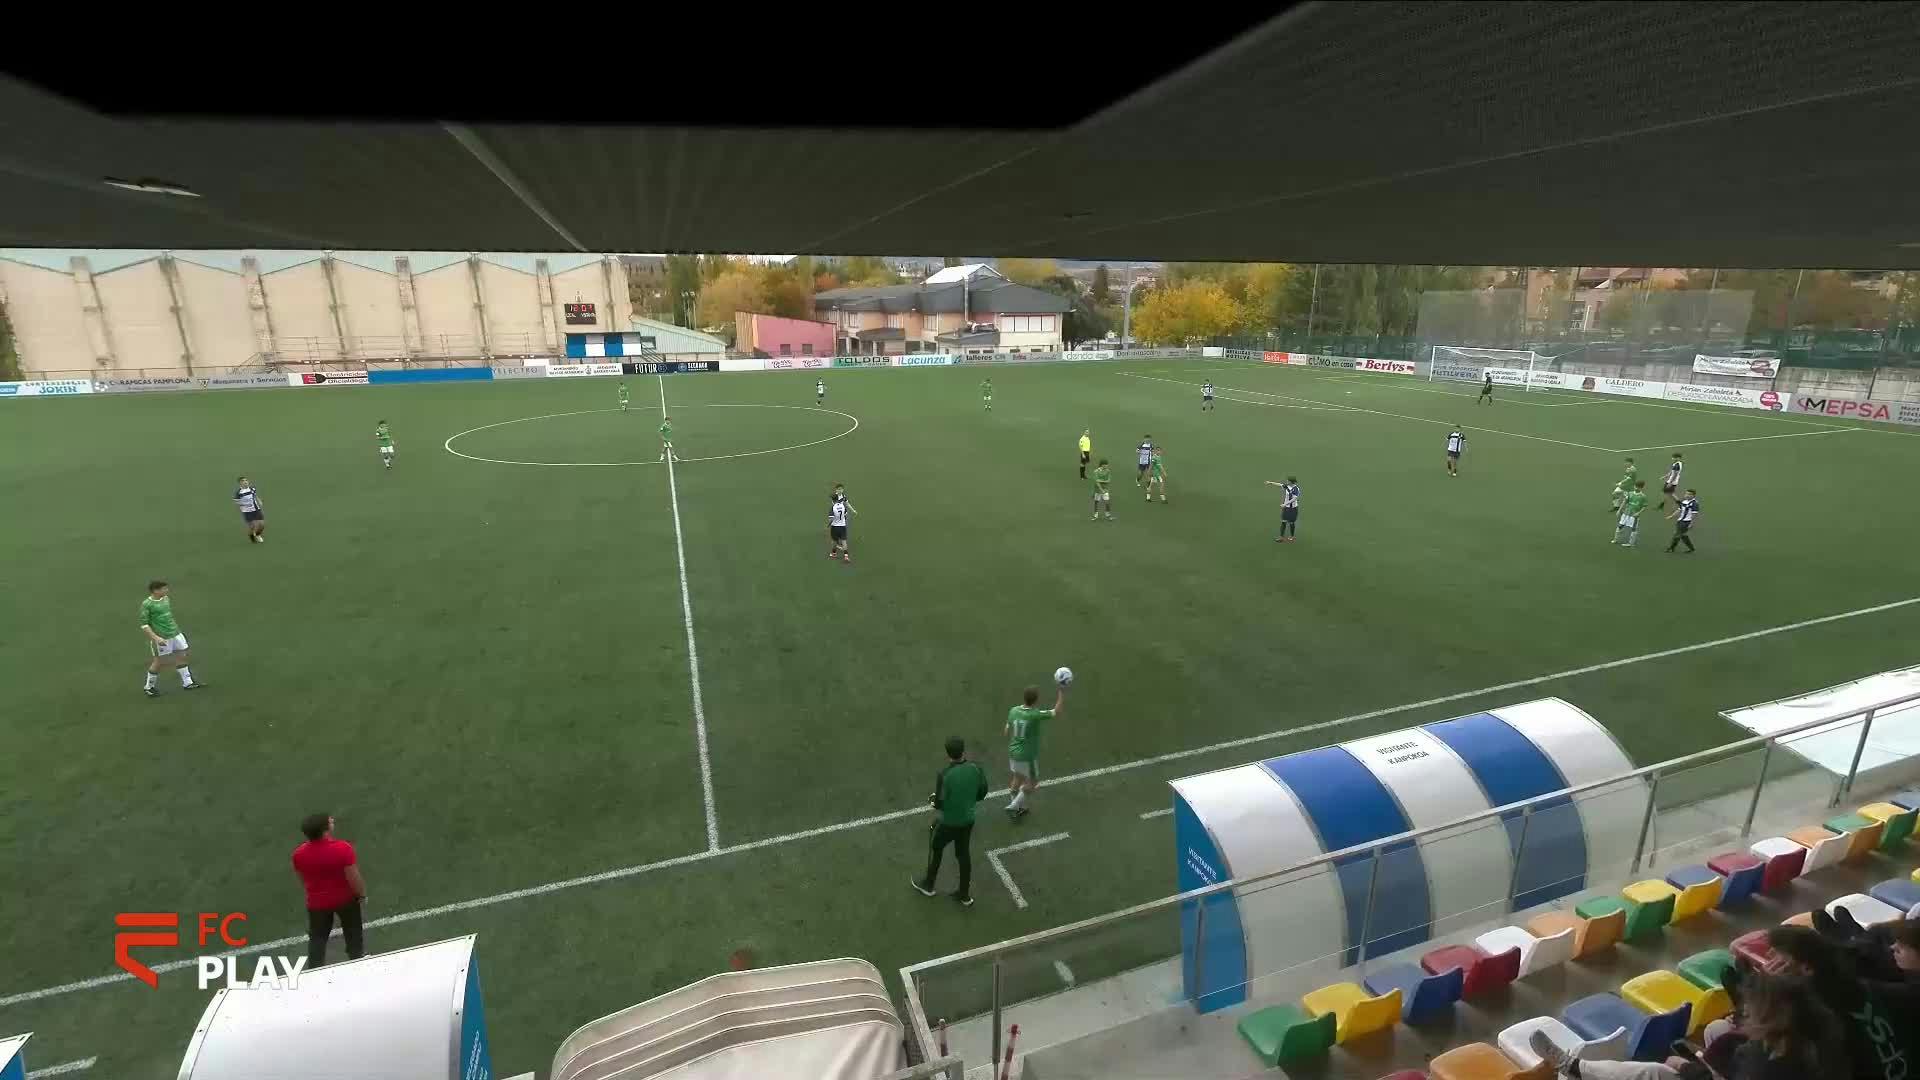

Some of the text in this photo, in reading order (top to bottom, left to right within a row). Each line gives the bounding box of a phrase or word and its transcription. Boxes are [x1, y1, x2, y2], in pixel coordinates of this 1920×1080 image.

[839, 356, 890, 364] TOLDOS
[634, 363, 658, 374] FUTUR
[1365, 360, 1405, 372] Berlys
[1605, 378, 1645, 388] CALDERO
[1806, 398, 1889, 420] MEPSA
